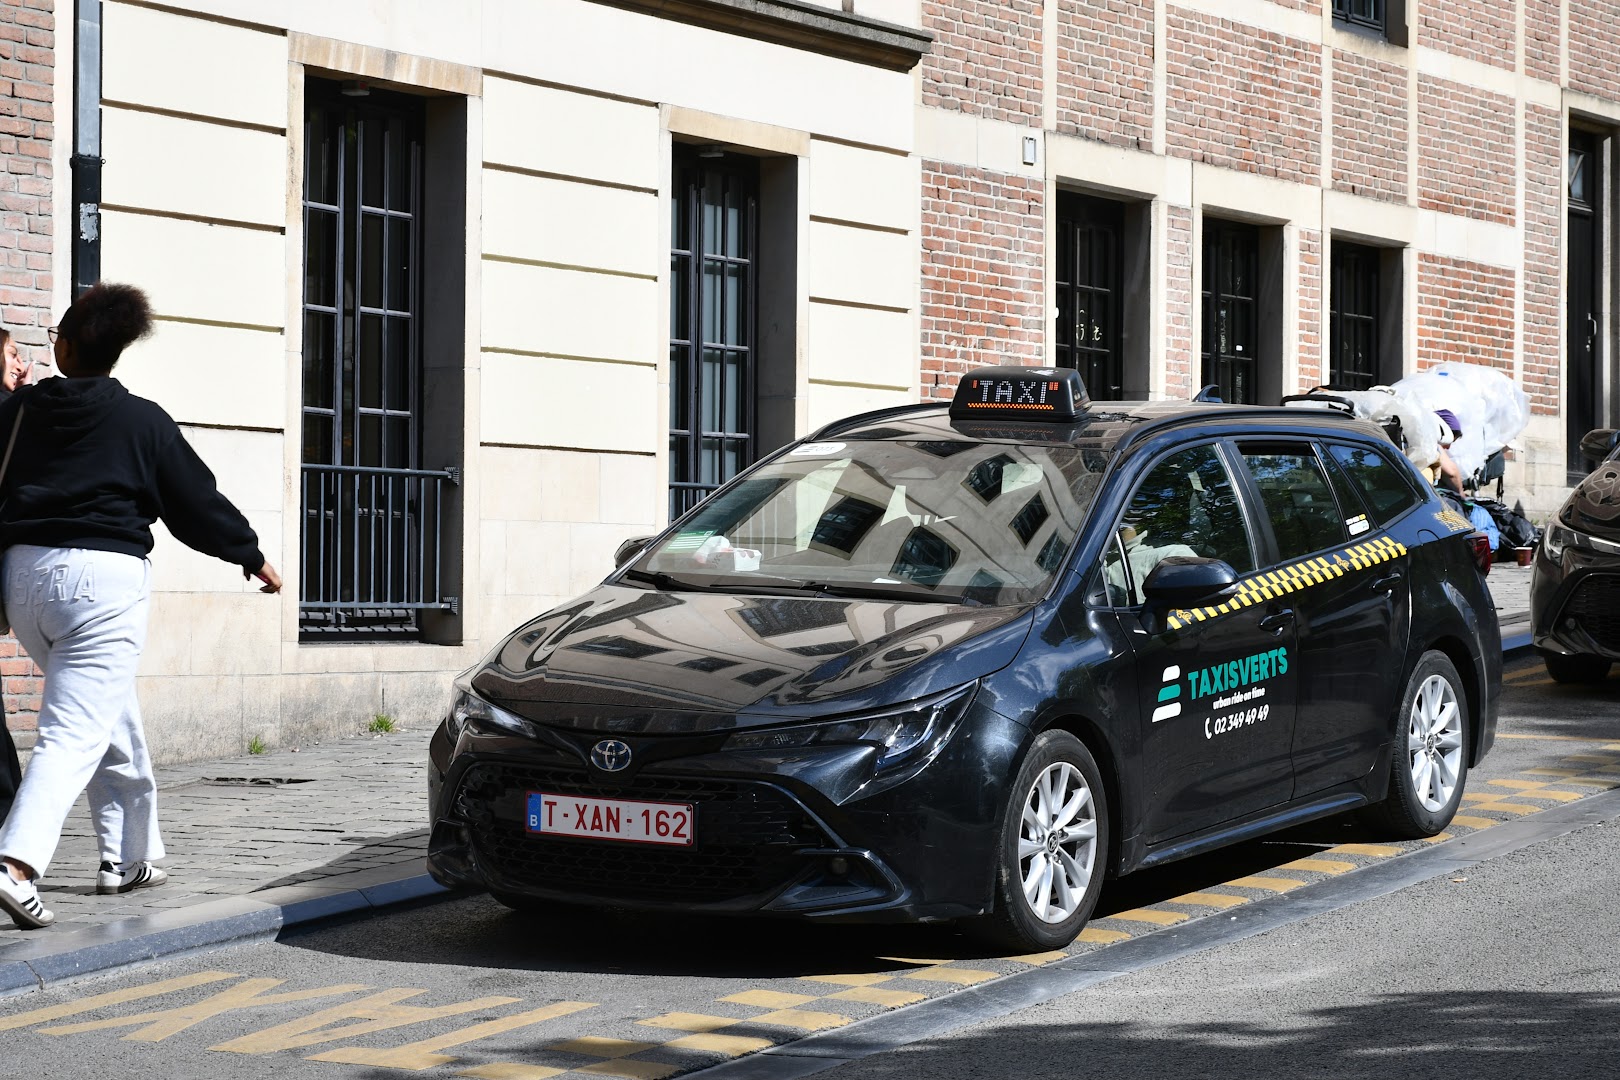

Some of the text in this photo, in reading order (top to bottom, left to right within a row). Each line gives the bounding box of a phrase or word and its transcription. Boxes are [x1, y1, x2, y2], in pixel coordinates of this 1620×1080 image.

[979, 380, 1048, 404] TAXI
[1187, 646, 1289, 700] TAXISVERTS
[1212, 686, 1266, 710] urban ride on time
[1214, 704, 1270, 735] 02 349 49 49
[529, 814, 538, 827] B
